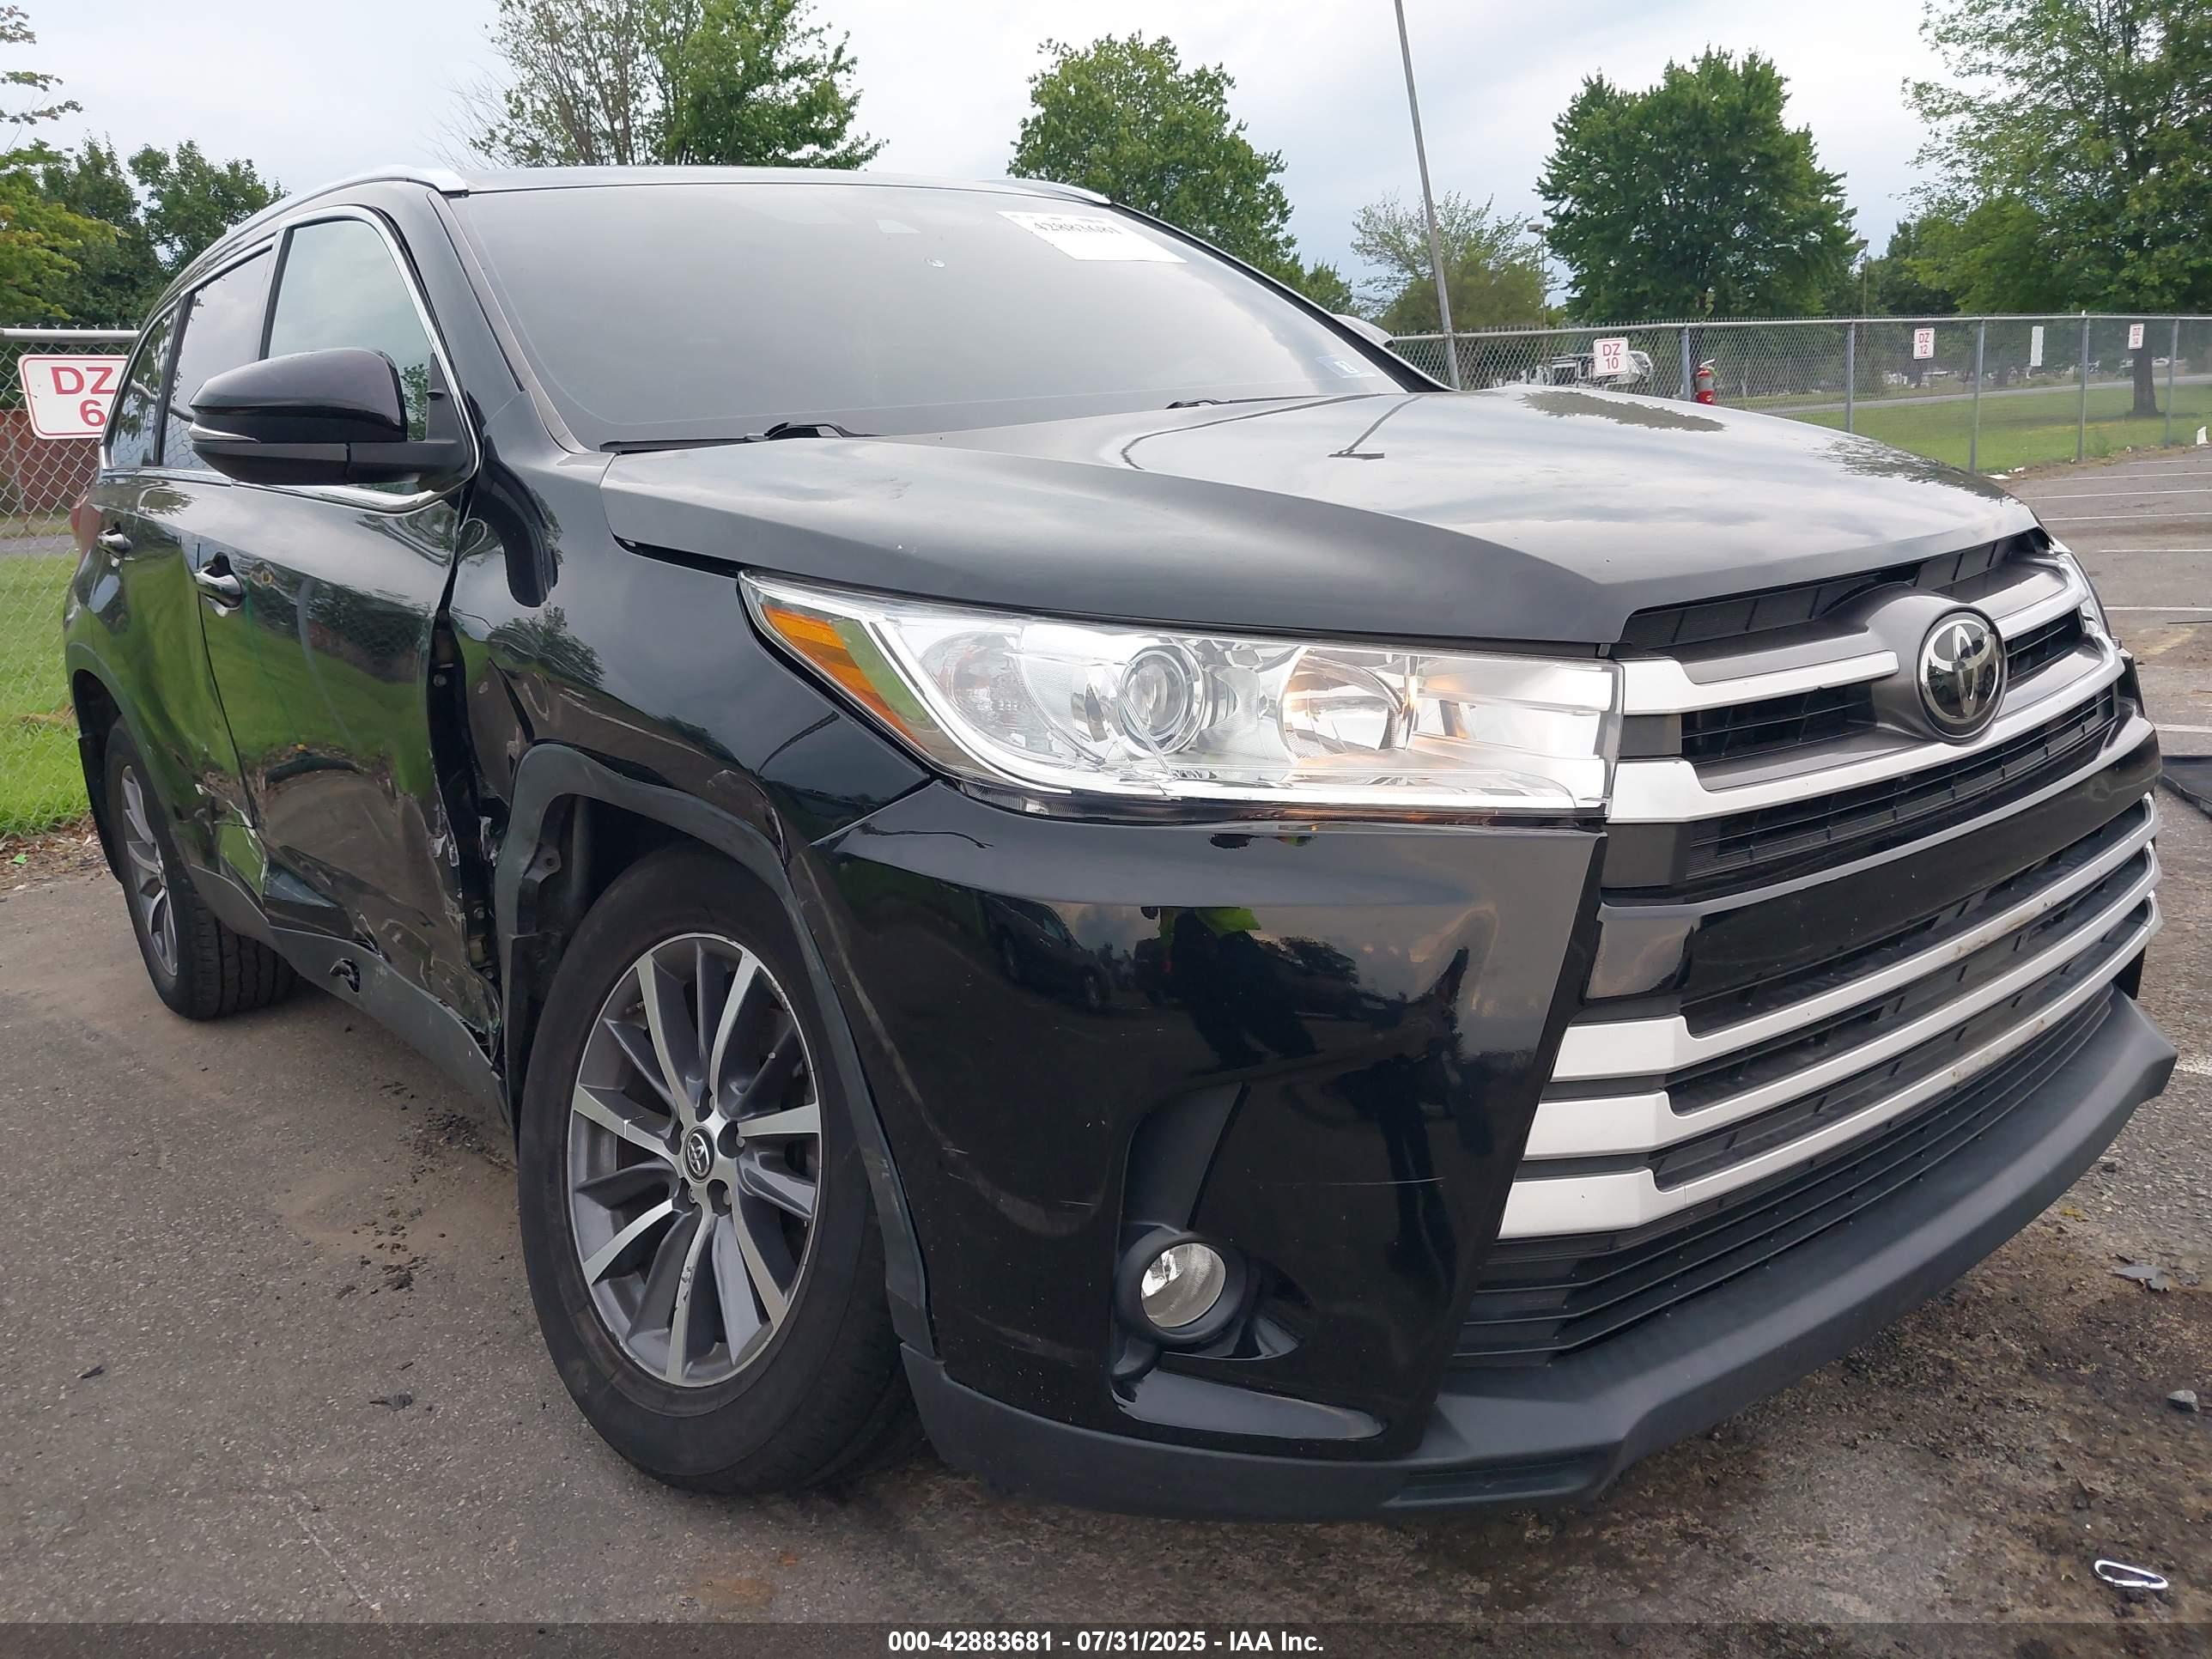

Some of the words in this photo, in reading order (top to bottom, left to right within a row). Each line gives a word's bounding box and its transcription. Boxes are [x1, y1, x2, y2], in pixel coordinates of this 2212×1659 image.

[1919, 332, 1929, 343] DZ
[1602, 343, 1620, 356] DZ
[1920, 344, 1928, 355] 12
[1606, 357, 1619, 369] 10
[51, 367, 116, 395] DZ
[80, 399, 106, 427] 6
